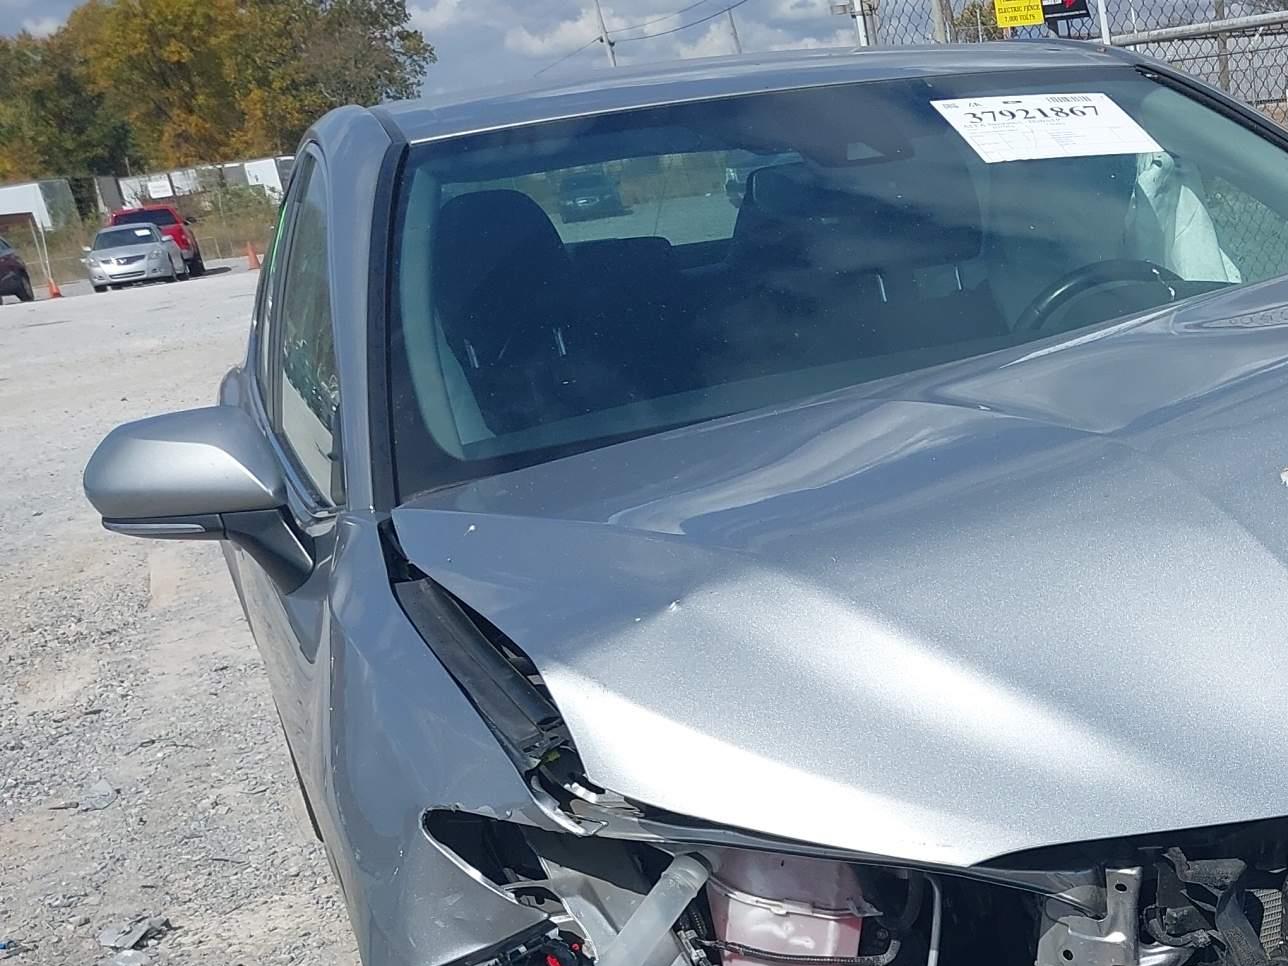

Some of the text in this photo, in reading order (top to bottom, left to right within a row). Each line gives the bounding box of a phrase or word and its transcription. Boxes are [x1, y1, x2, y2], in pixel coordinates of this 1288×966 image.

[997, 4, 1040, 14] ELECTRIC FENCE
[963, 105, 1100, 124] 37921867
